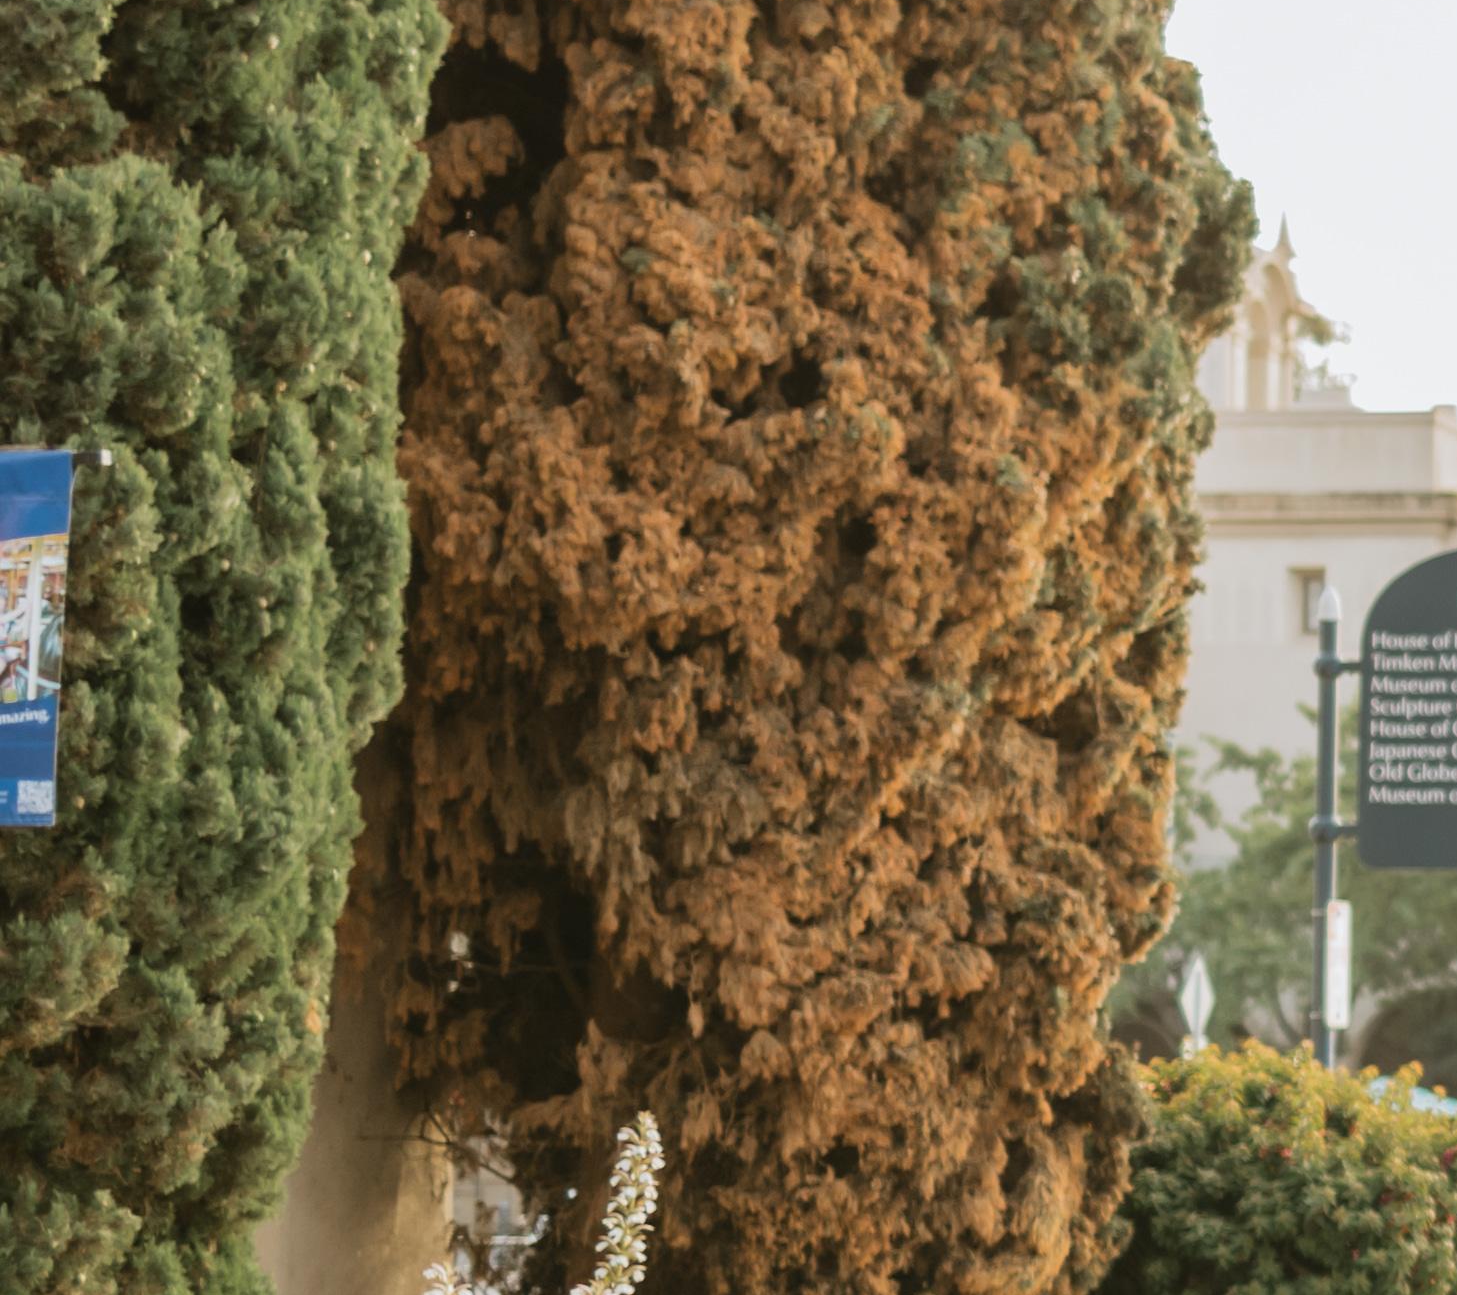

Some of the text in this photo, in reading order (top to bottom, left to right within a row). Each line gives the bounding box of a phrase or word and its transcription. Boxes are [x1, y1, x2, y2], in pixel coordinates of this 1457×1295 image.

[1371, 631, 1428, 650] House
[1432, 631, 1451, 650] of
[1372, 653, 1434, 672] Timken
[1370, 675, 1447, 693] Museum
[1370, 697, 1452, 719] Sculpture
[1370, 719, 1427, 737] House
[1430, 719, 1450, 737] of
[1369, 741, 1447, 763] Japanese
[1368, 763, 1403, 782] Old
[1368, 785, 1444, 803] Museum
